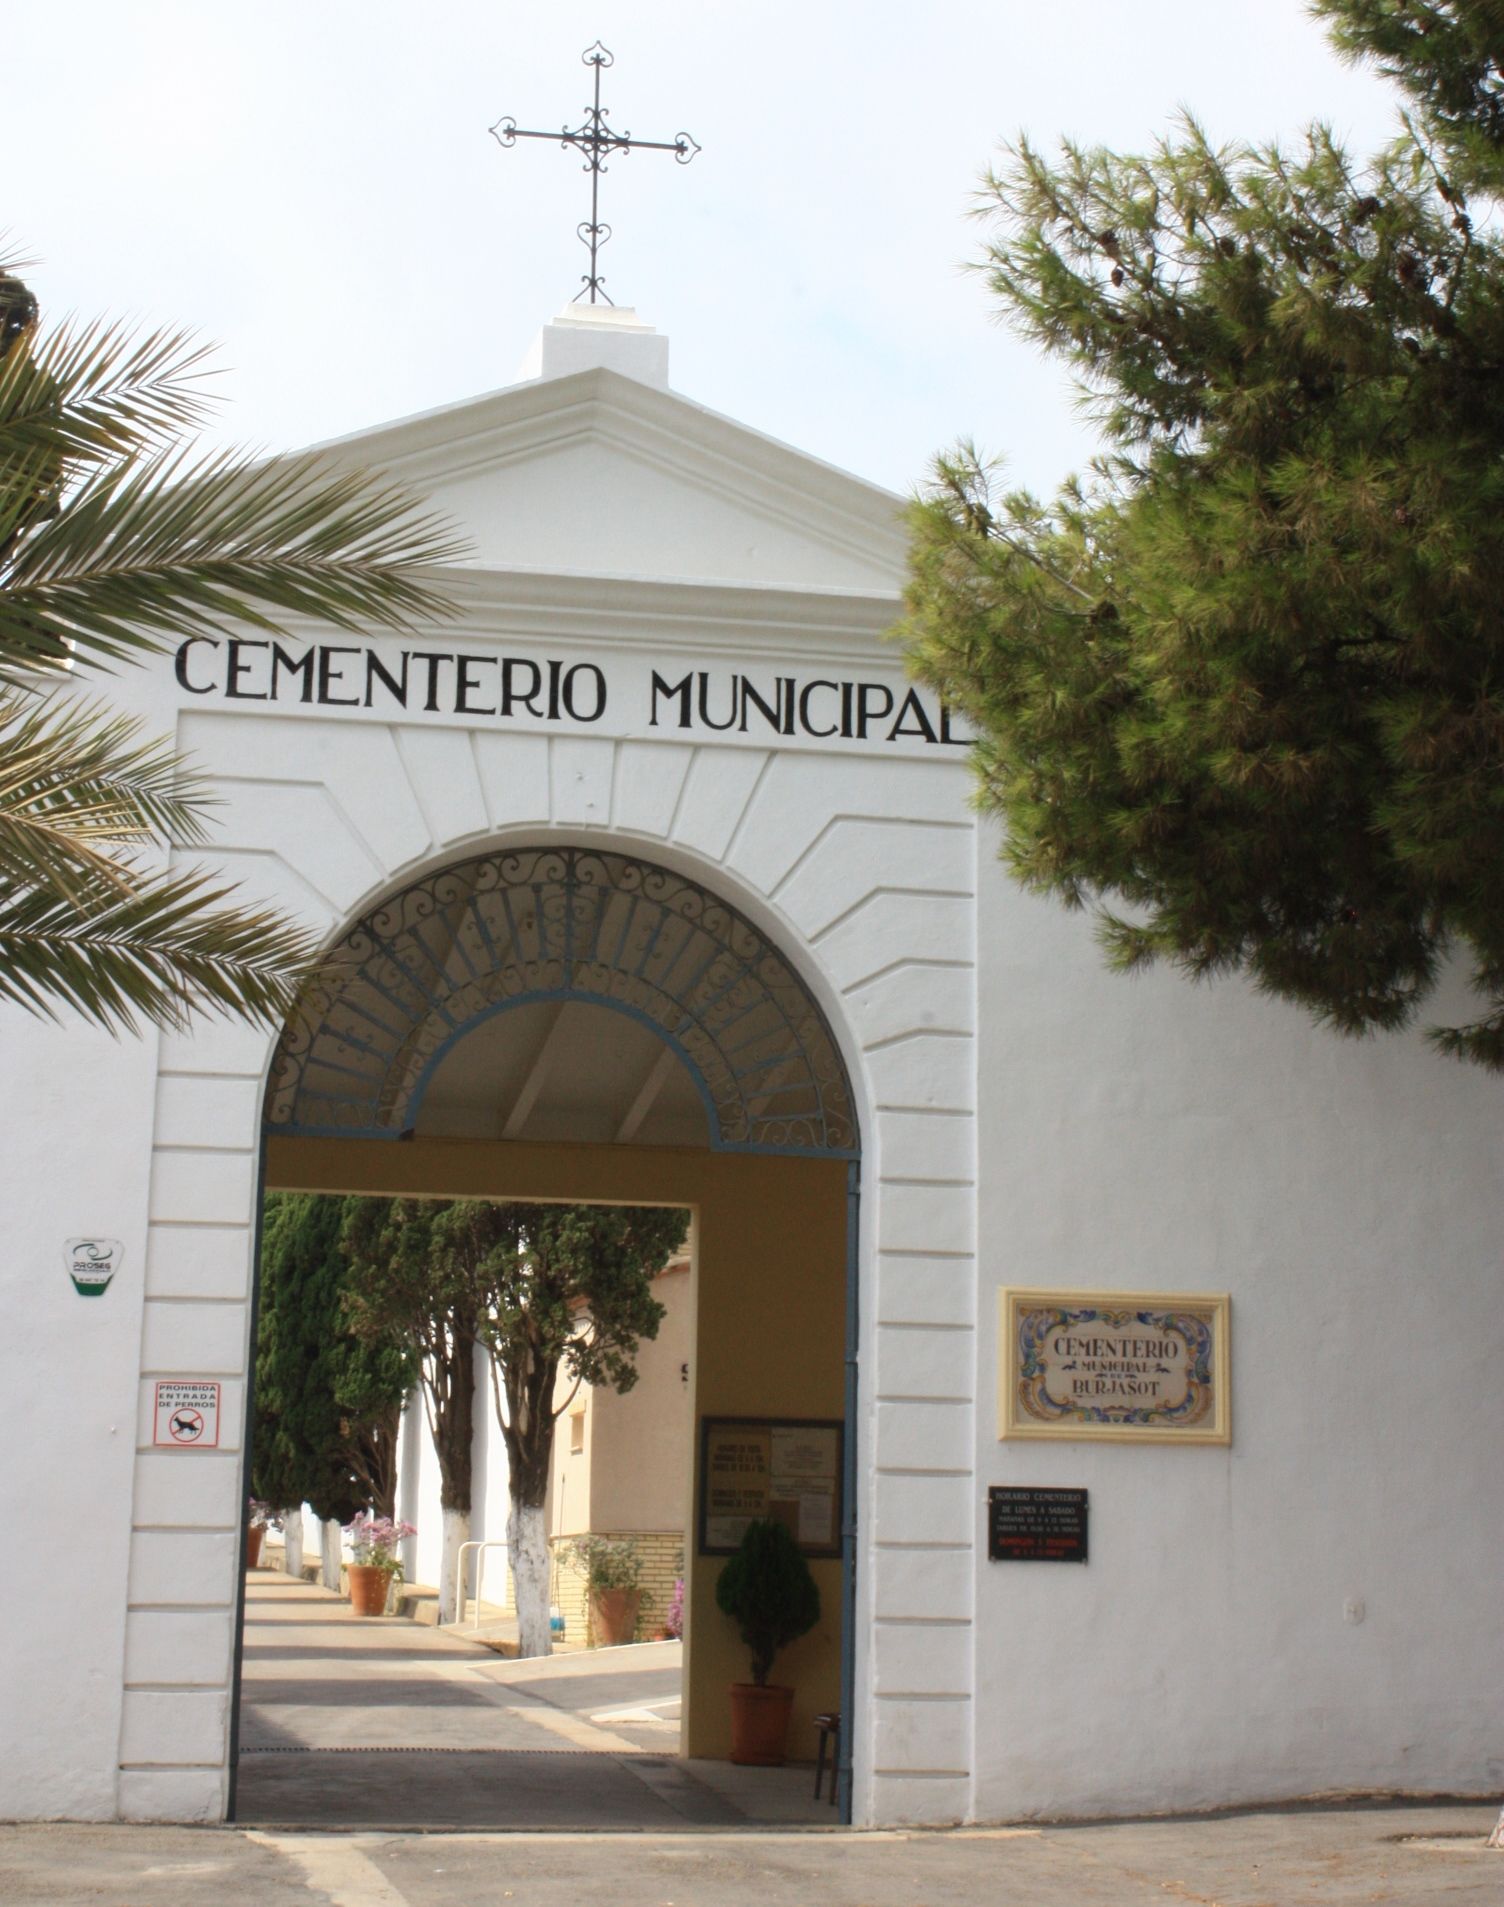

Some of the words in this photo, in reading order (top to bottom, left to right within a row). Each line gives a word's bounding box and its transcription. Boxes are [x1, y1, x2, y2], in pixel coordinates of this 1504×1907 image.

[174, 636, 607, 722] CEMENTERIO
[1054, 1337, 1178, 1359] CEMENTERIO
[1081, 1360, 1150, 1373] MUNICIPAL
[1072, 1379, 1160, 1397] BURJASOT
[995, 1492, 1030, 1501] HORARIO
[1034, 1493, 1081, 1502] CEMENTERIO
